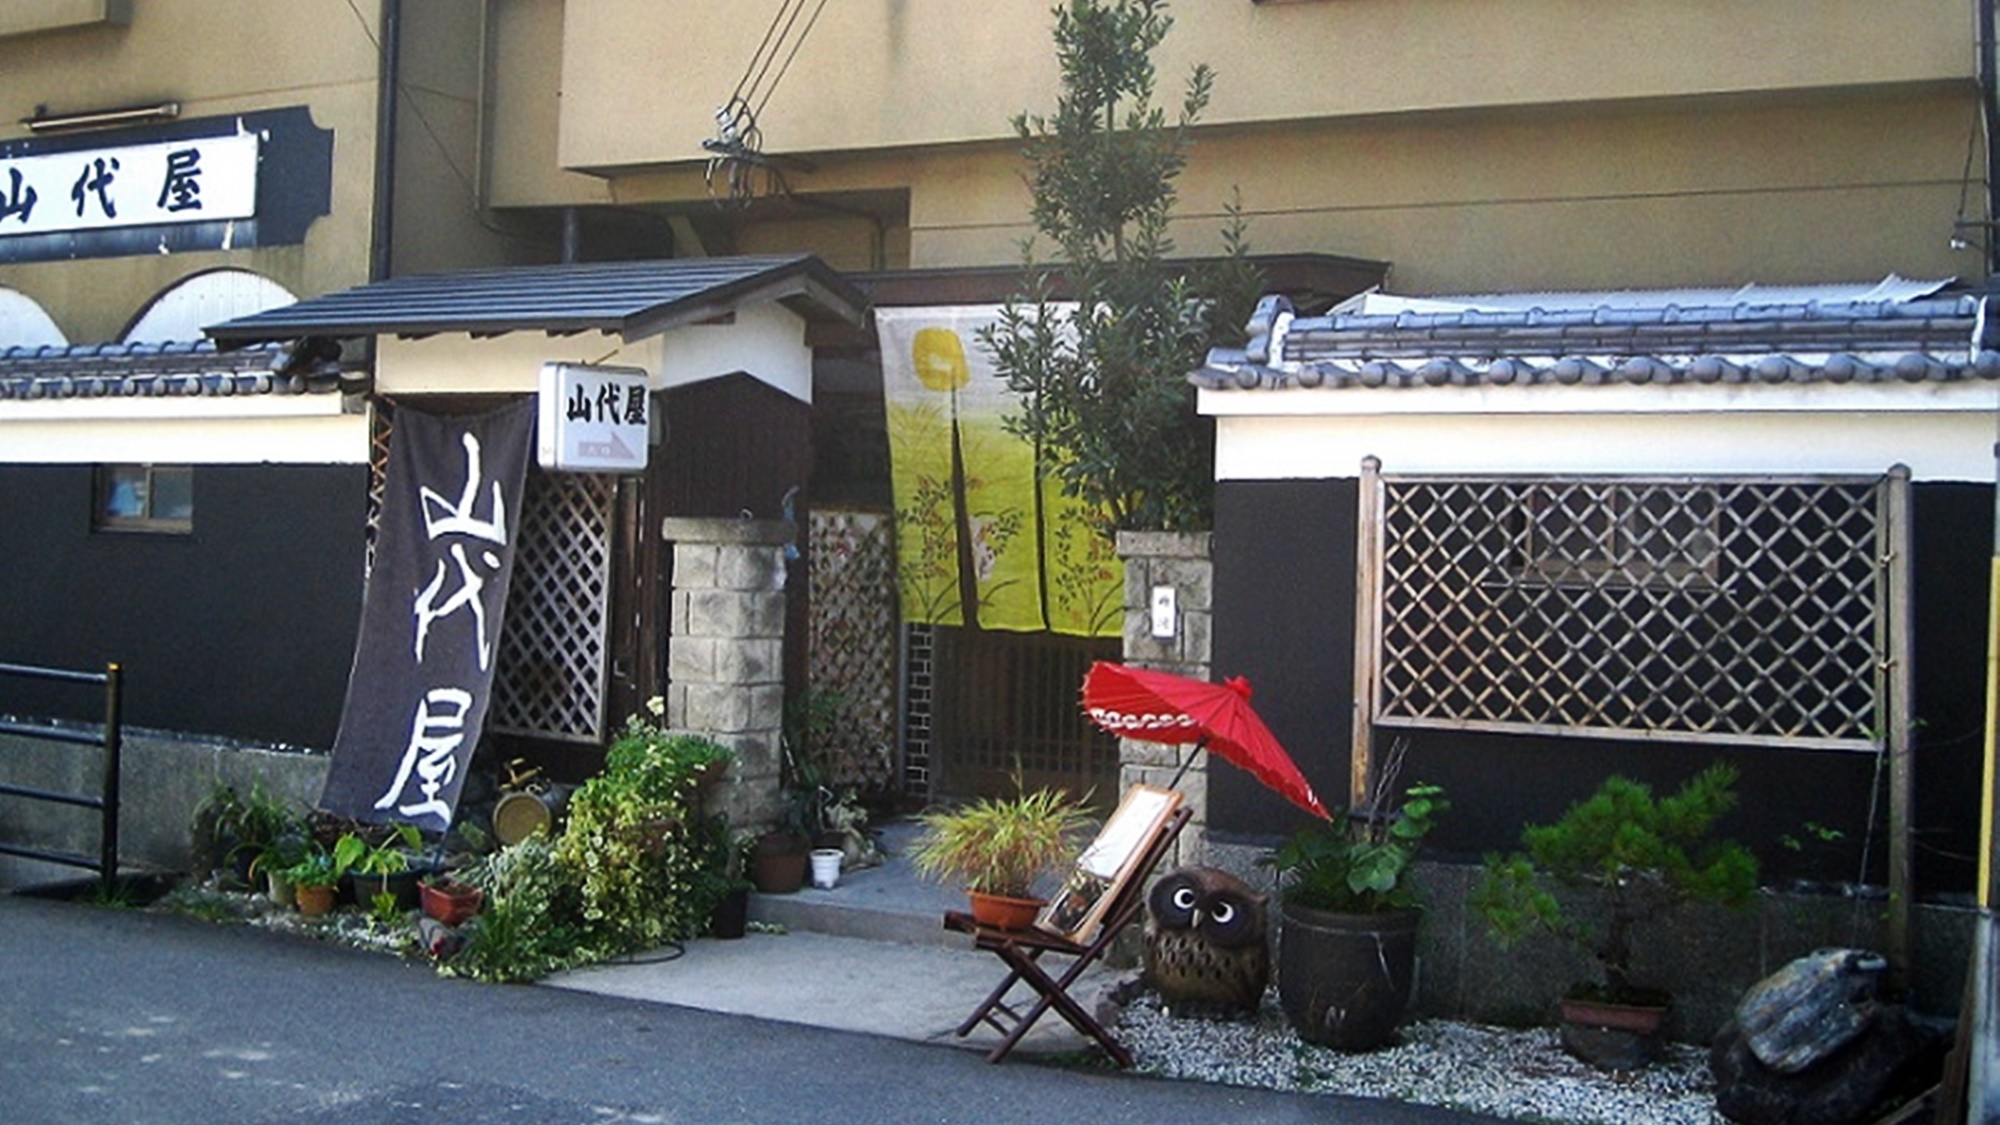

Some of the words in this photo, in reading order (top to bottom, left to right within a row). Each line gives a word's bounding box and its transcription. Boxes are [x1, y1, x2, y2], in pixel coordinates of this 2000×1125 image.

[0, 148, 203, 223] 山代屋
[566, 381, 647, 425] 山代屋
[374, 431, 507, 832] 山代屋
